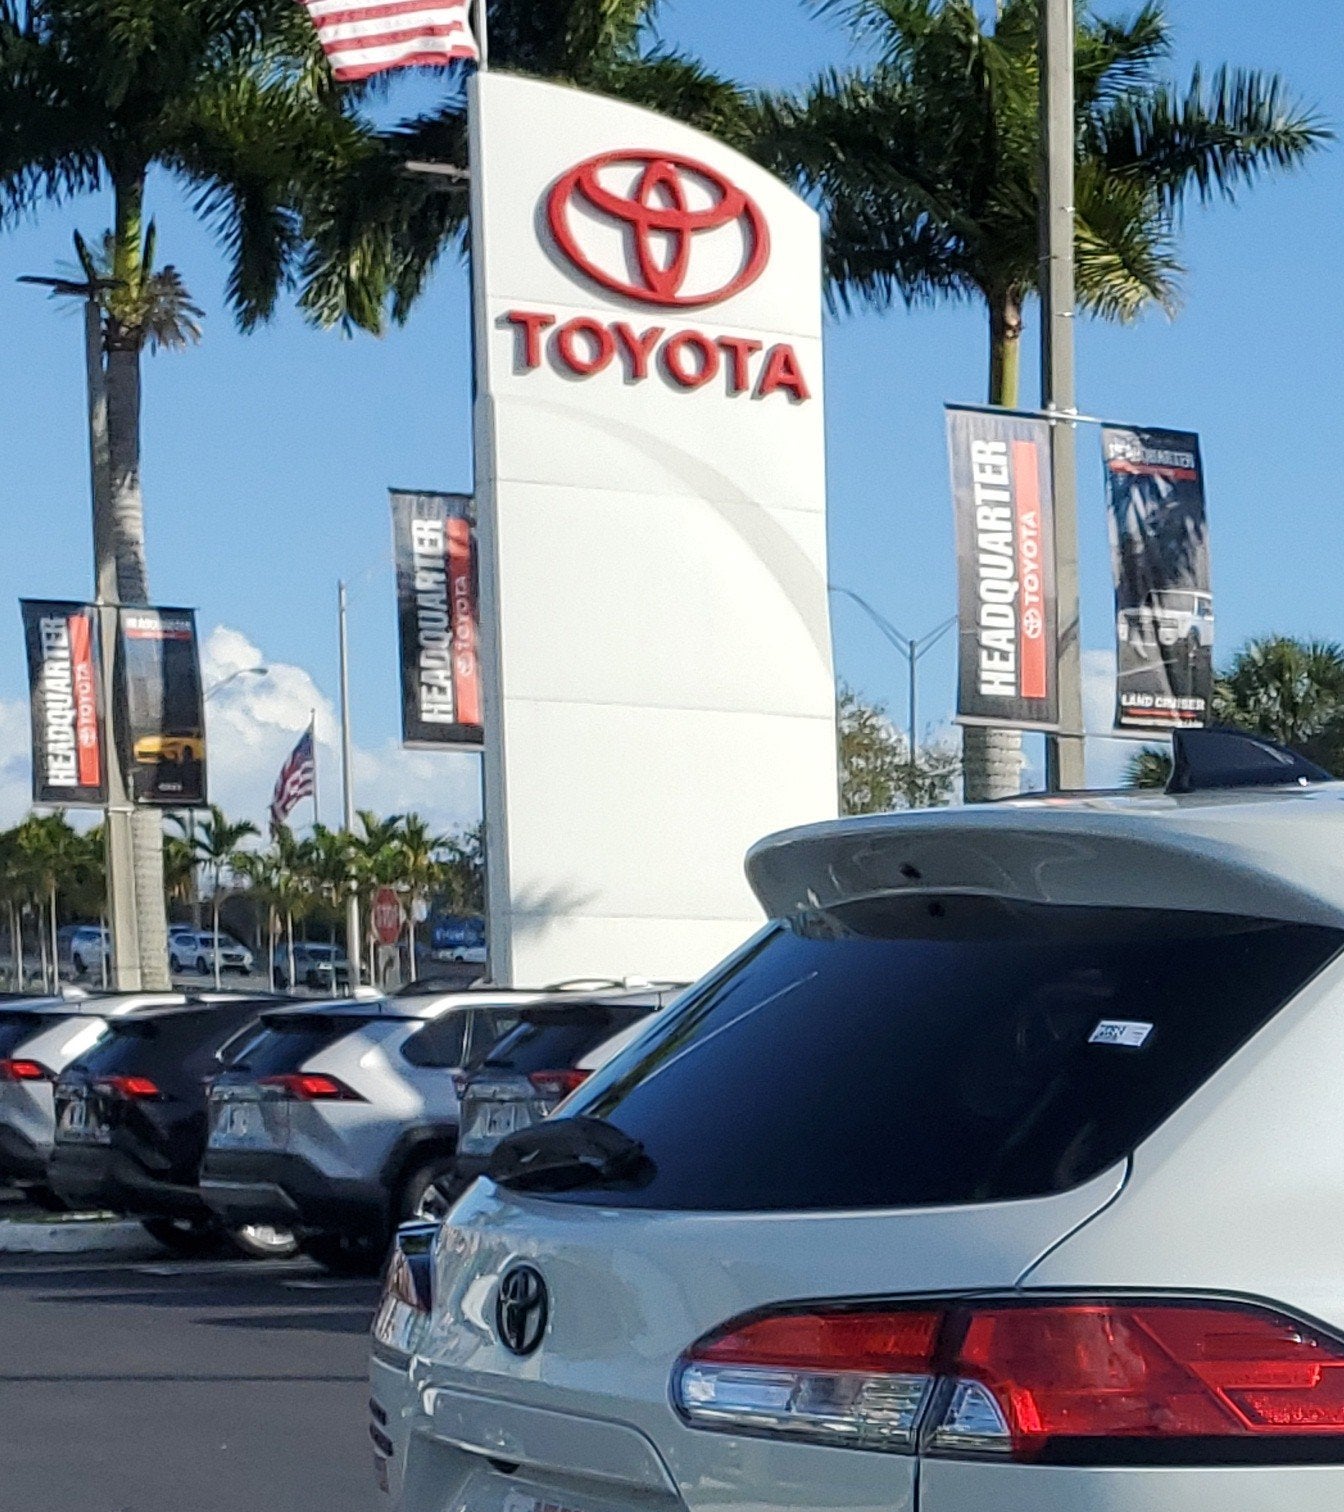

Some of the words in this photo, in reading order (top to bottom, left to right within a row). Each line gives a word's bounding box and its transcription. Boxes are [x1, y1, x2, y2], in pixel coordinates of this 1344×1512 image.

[501, 310, 811, 403] TOYOTA
[411, 519, 454, 724] HEADQUARTER
[971, 439, 1018, 697] HEADQUARTER
[1020, 511, 1040, 607] TOYOTA
[40, 617, 79, 787] HEADQUARTER
[1122, 693, 1154, 707] LAND
